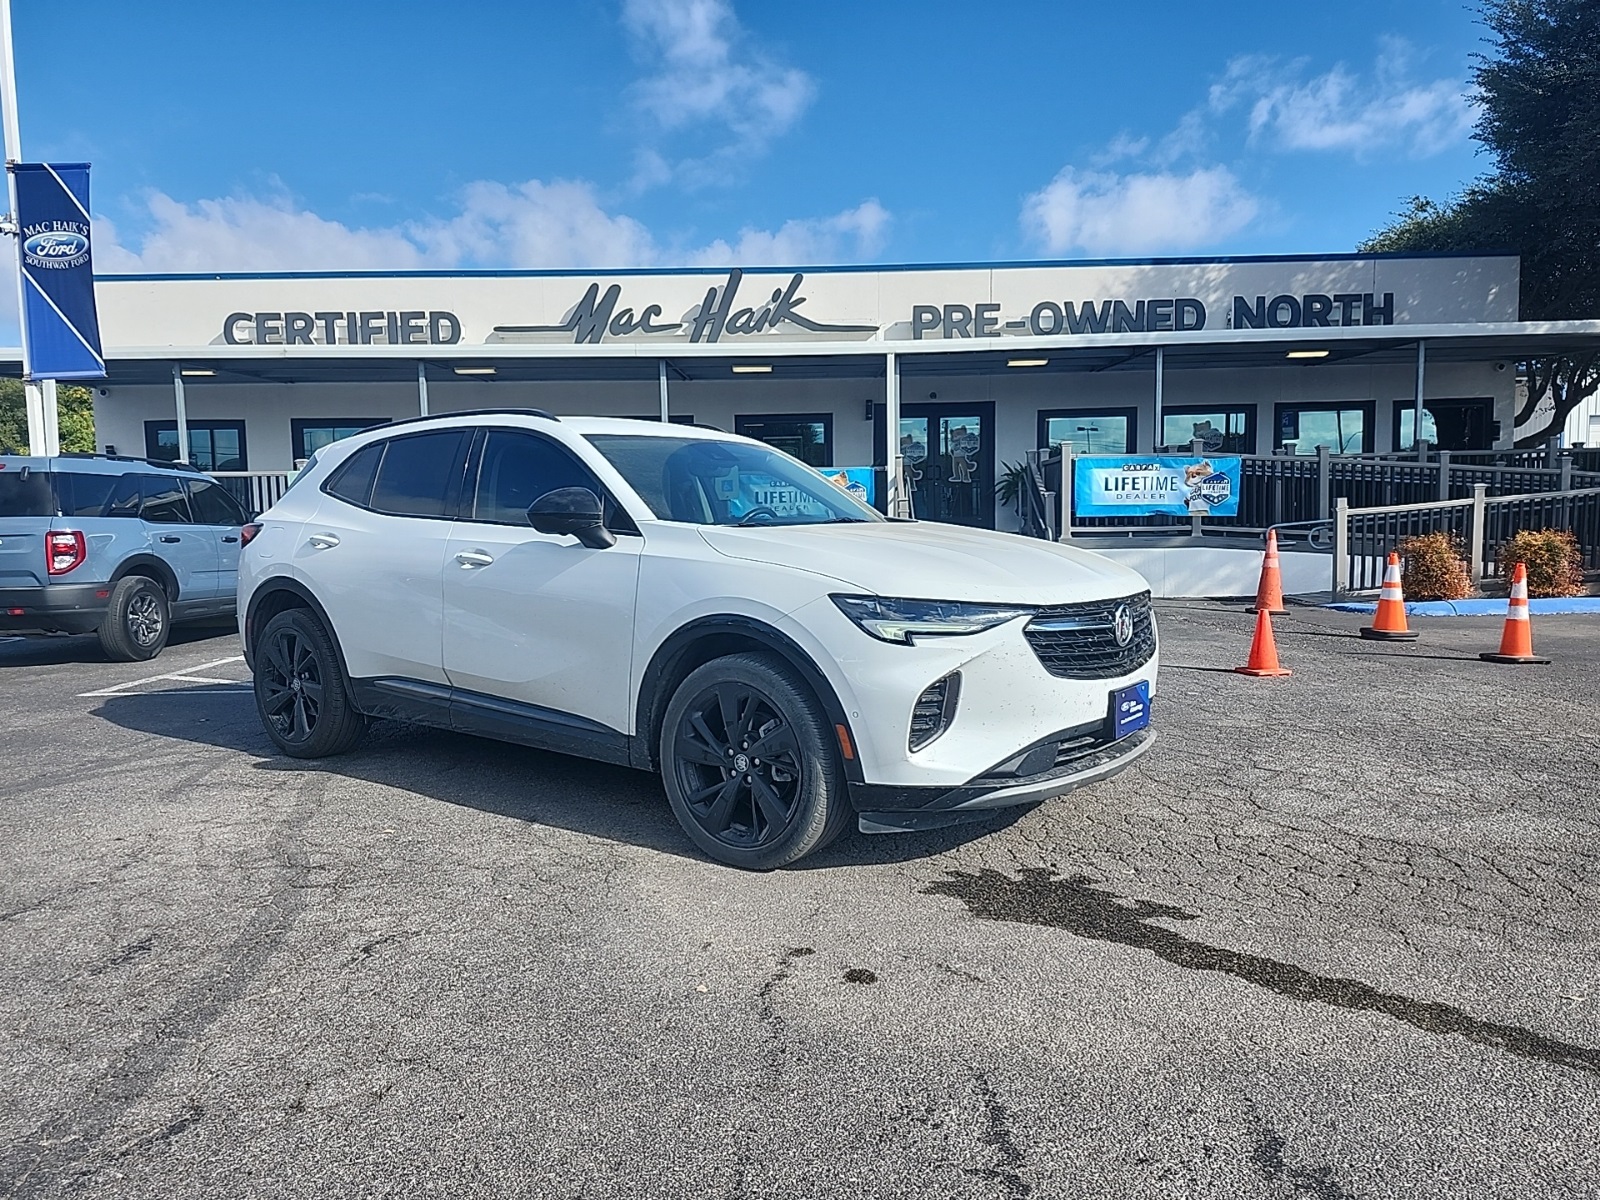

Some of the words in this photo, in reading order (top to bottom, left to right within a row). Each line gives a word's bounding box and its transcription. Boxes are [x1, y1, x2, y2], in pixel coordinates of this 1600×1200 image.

[23, 221, 50, 238] MAC
[53, 221, 89, 236] HAIK'S
[36, 237, 78, 256] Ford
[25, 255, 70, 270] SOUTHWAY
[71, 253, 89, 267] FORD
[223, 311, 462, 345] CERTIFIED
[493, 282, 683, 344] Mac
[688, 268, 880, 344] Haik
[911, 297, 1207, 340] PRE-OWNED
[1232, 292, 1395, 330] NORTH
[1122, 464, 1160, 472] CARFAX
[1104, 476, 1178, 492] LIFETIME
